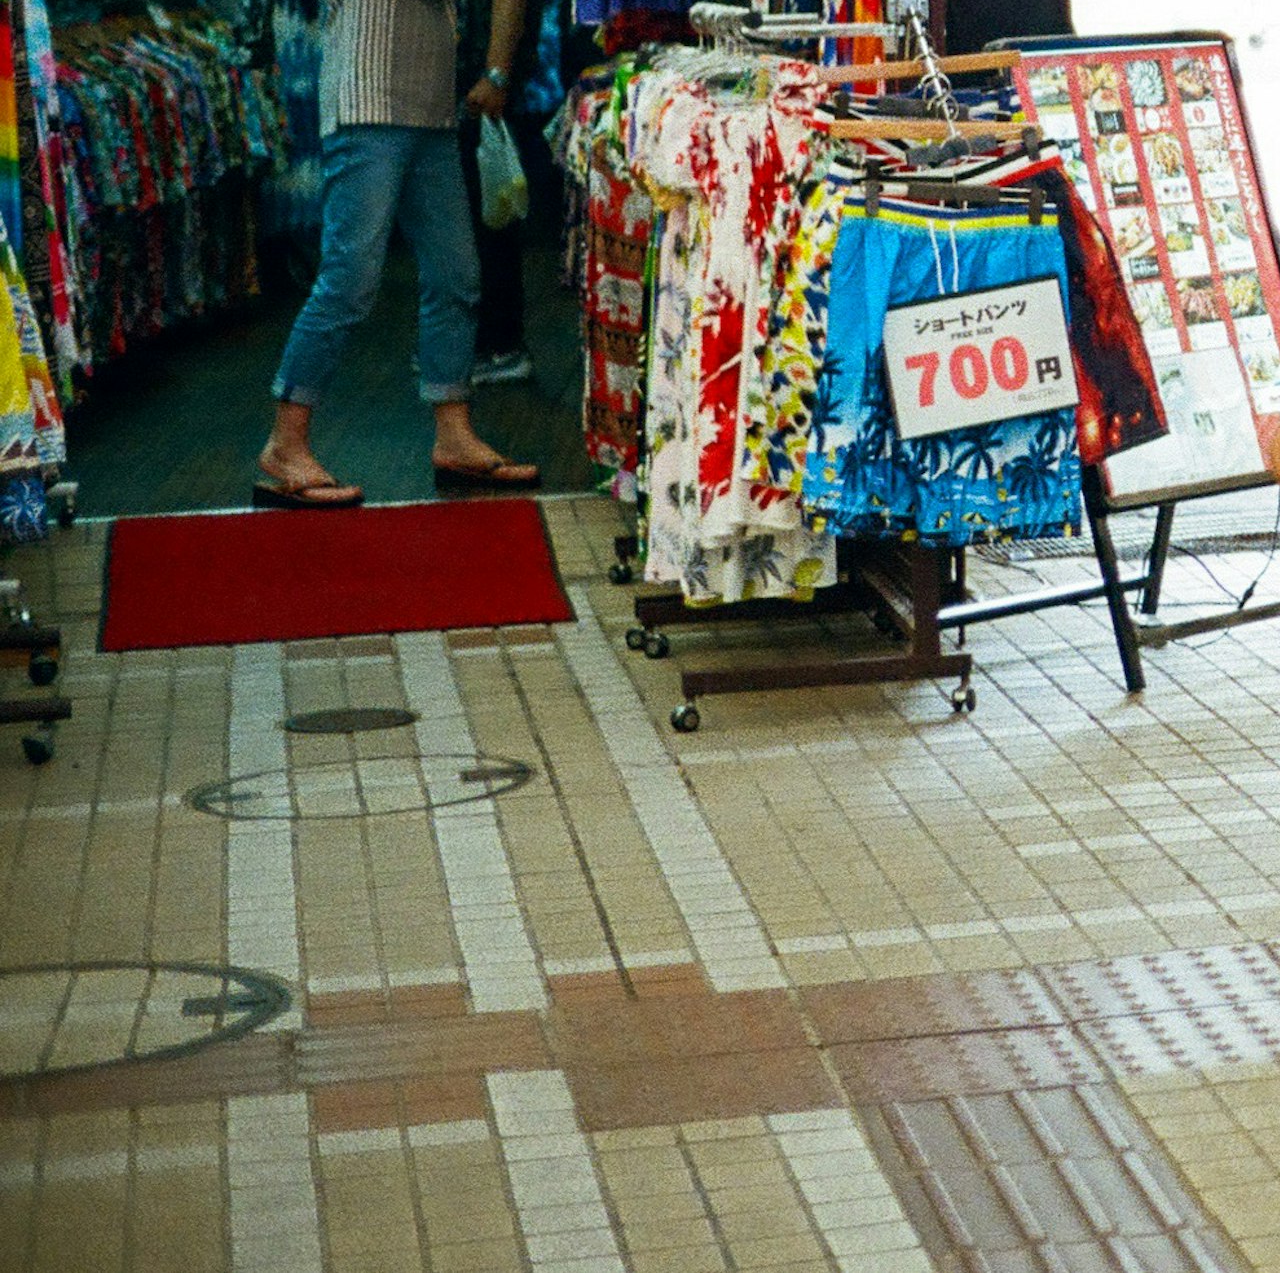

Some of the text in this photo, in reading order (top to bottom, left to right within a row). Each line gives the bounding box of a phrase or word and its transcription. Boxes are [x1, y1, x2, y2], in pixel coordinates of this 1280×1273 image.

[913, 299, 1028, 335] ショートパンツ
[950, 326, 994, 340] FREE SIZE
[904, 335, 1063, 408] 700円
